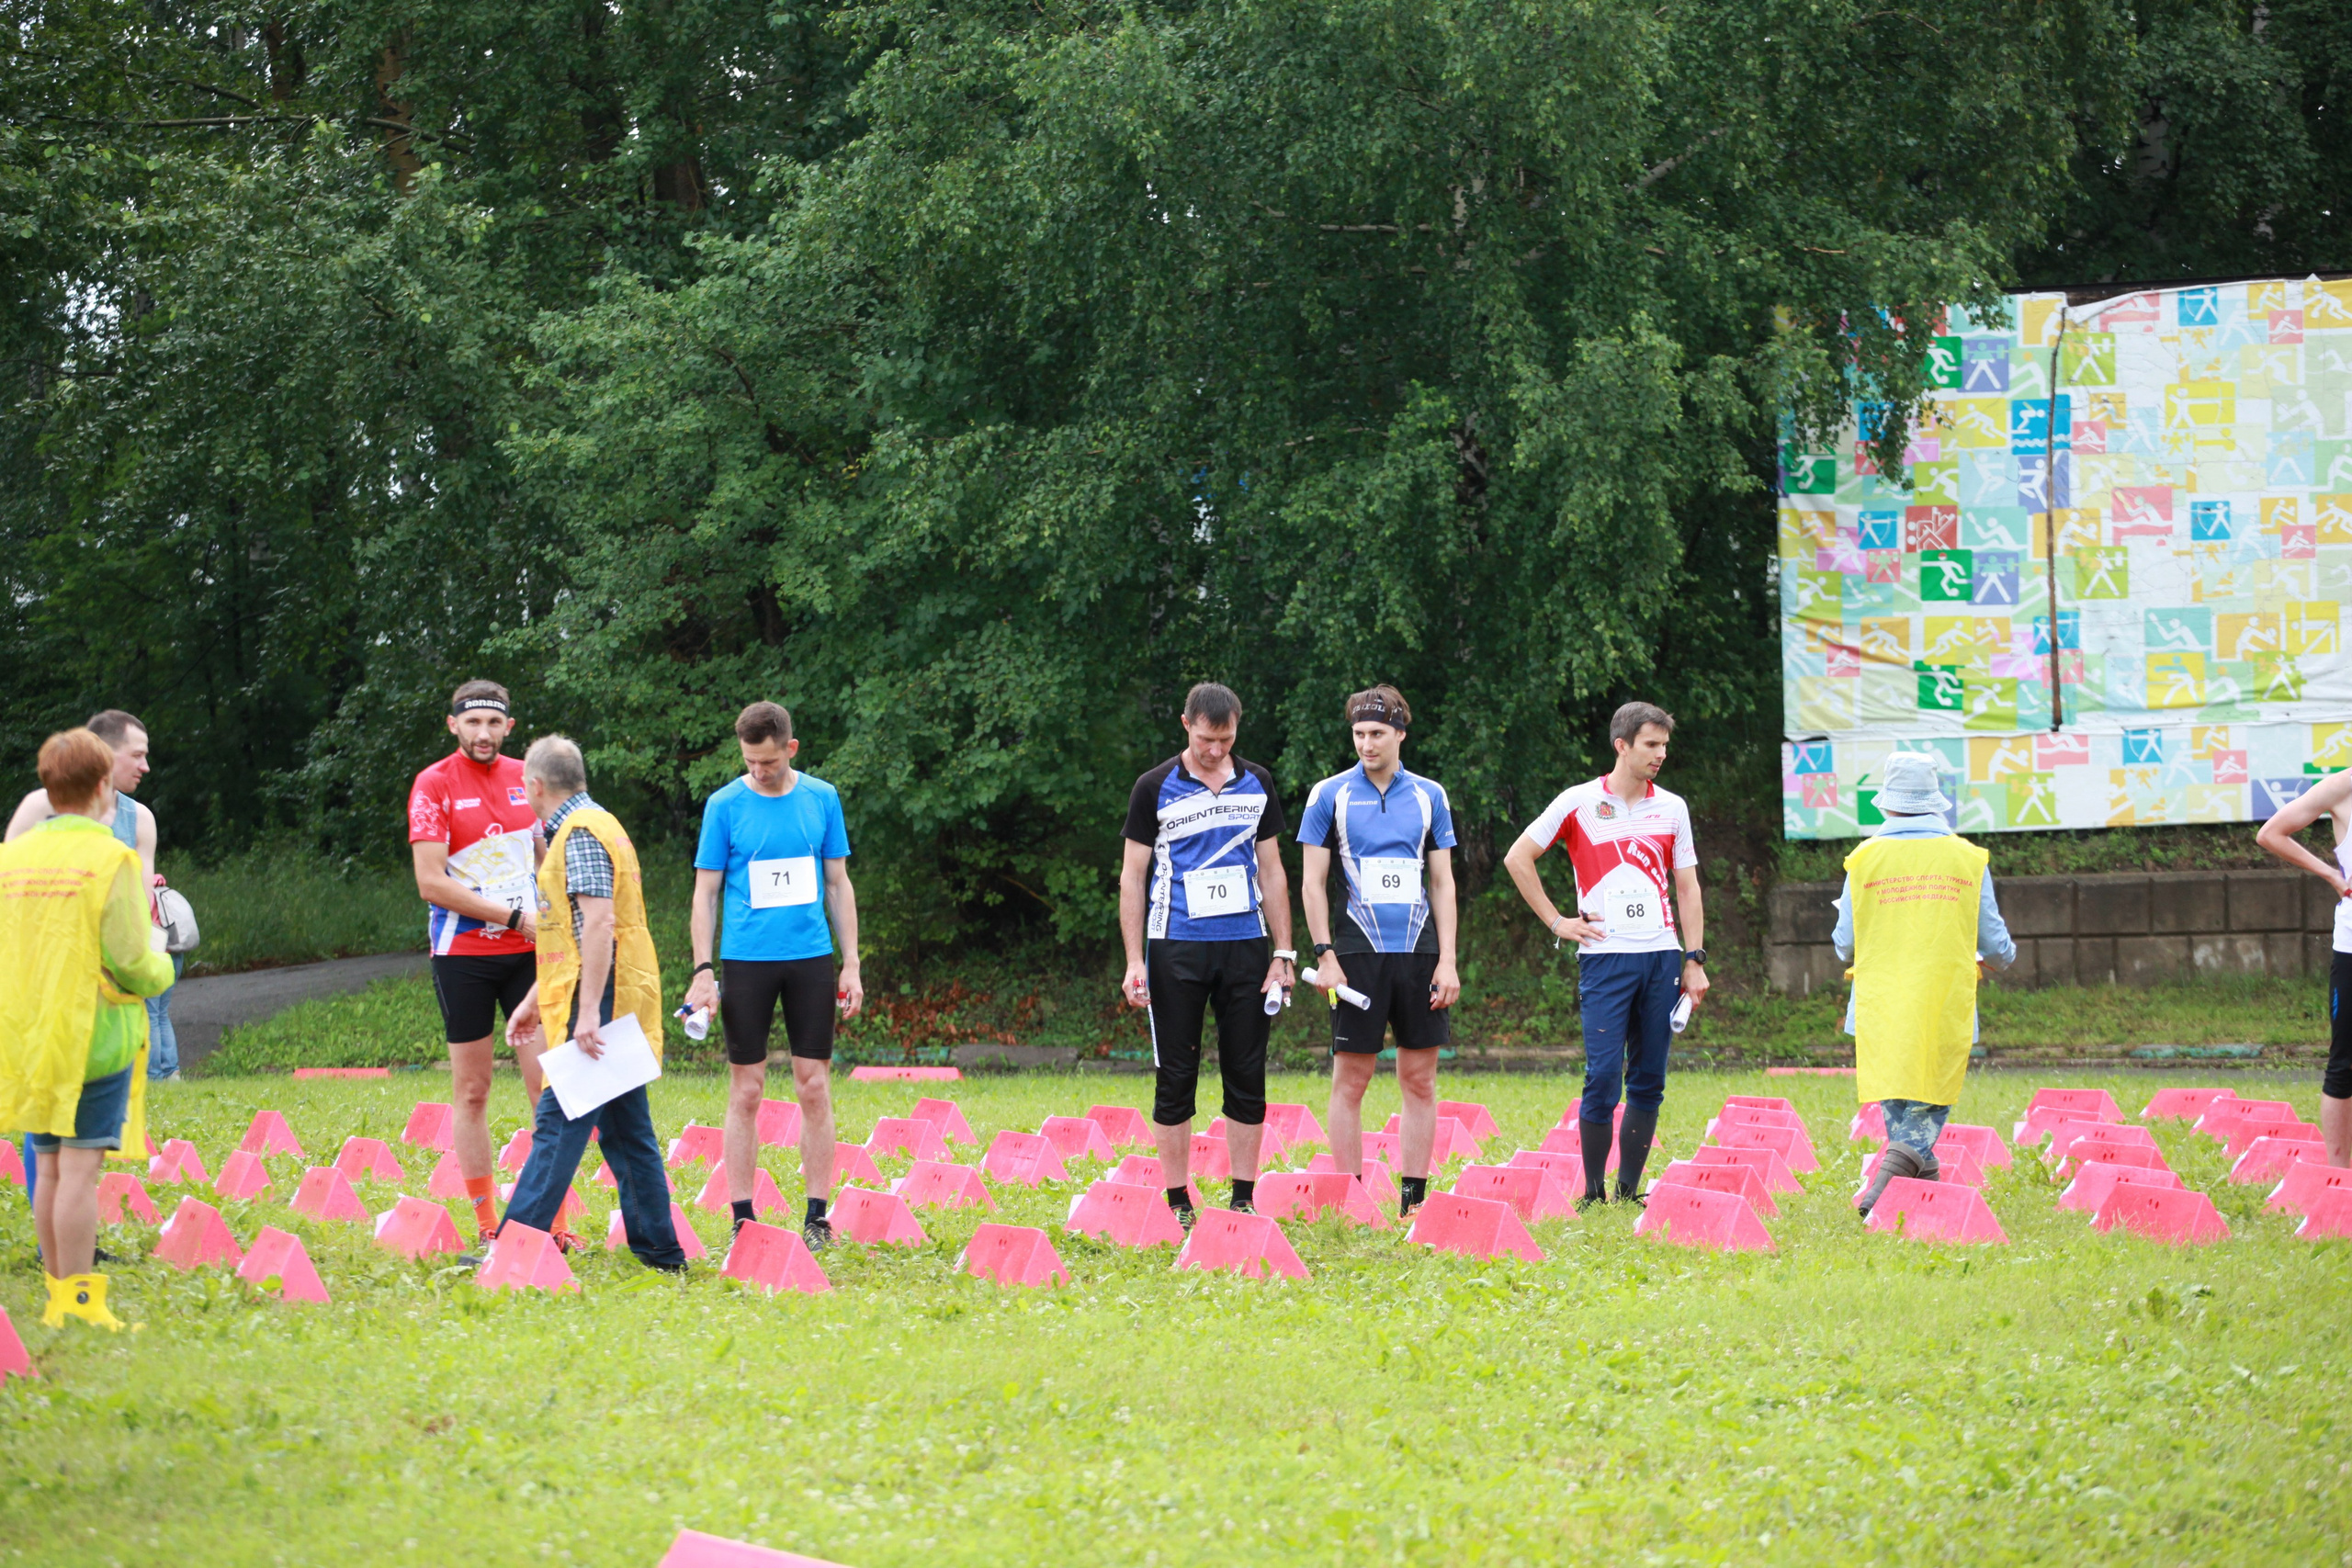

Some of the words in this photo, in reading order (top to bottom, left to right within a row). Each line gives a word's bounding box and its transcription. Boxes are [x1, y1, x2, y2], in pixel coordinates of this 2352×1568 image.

[1166, 805, 1261, 830] ORIENTEERING
[1227, 813, 1261, 821] SPORT
[1626, 840, 1651, 868] Run
[772, 871, 790, 886] 71
[1382, 874, 1401, 888] 69
[1863, 875, 1914, 890] МИНИСТЕРСТВО
[1945, 875, 1973, 886] ТУРИЗМА
[1207, 884, 1227, 900] 70
[506, 896, 524, 909] 72
[1626, 903, 1645, 918] 68
